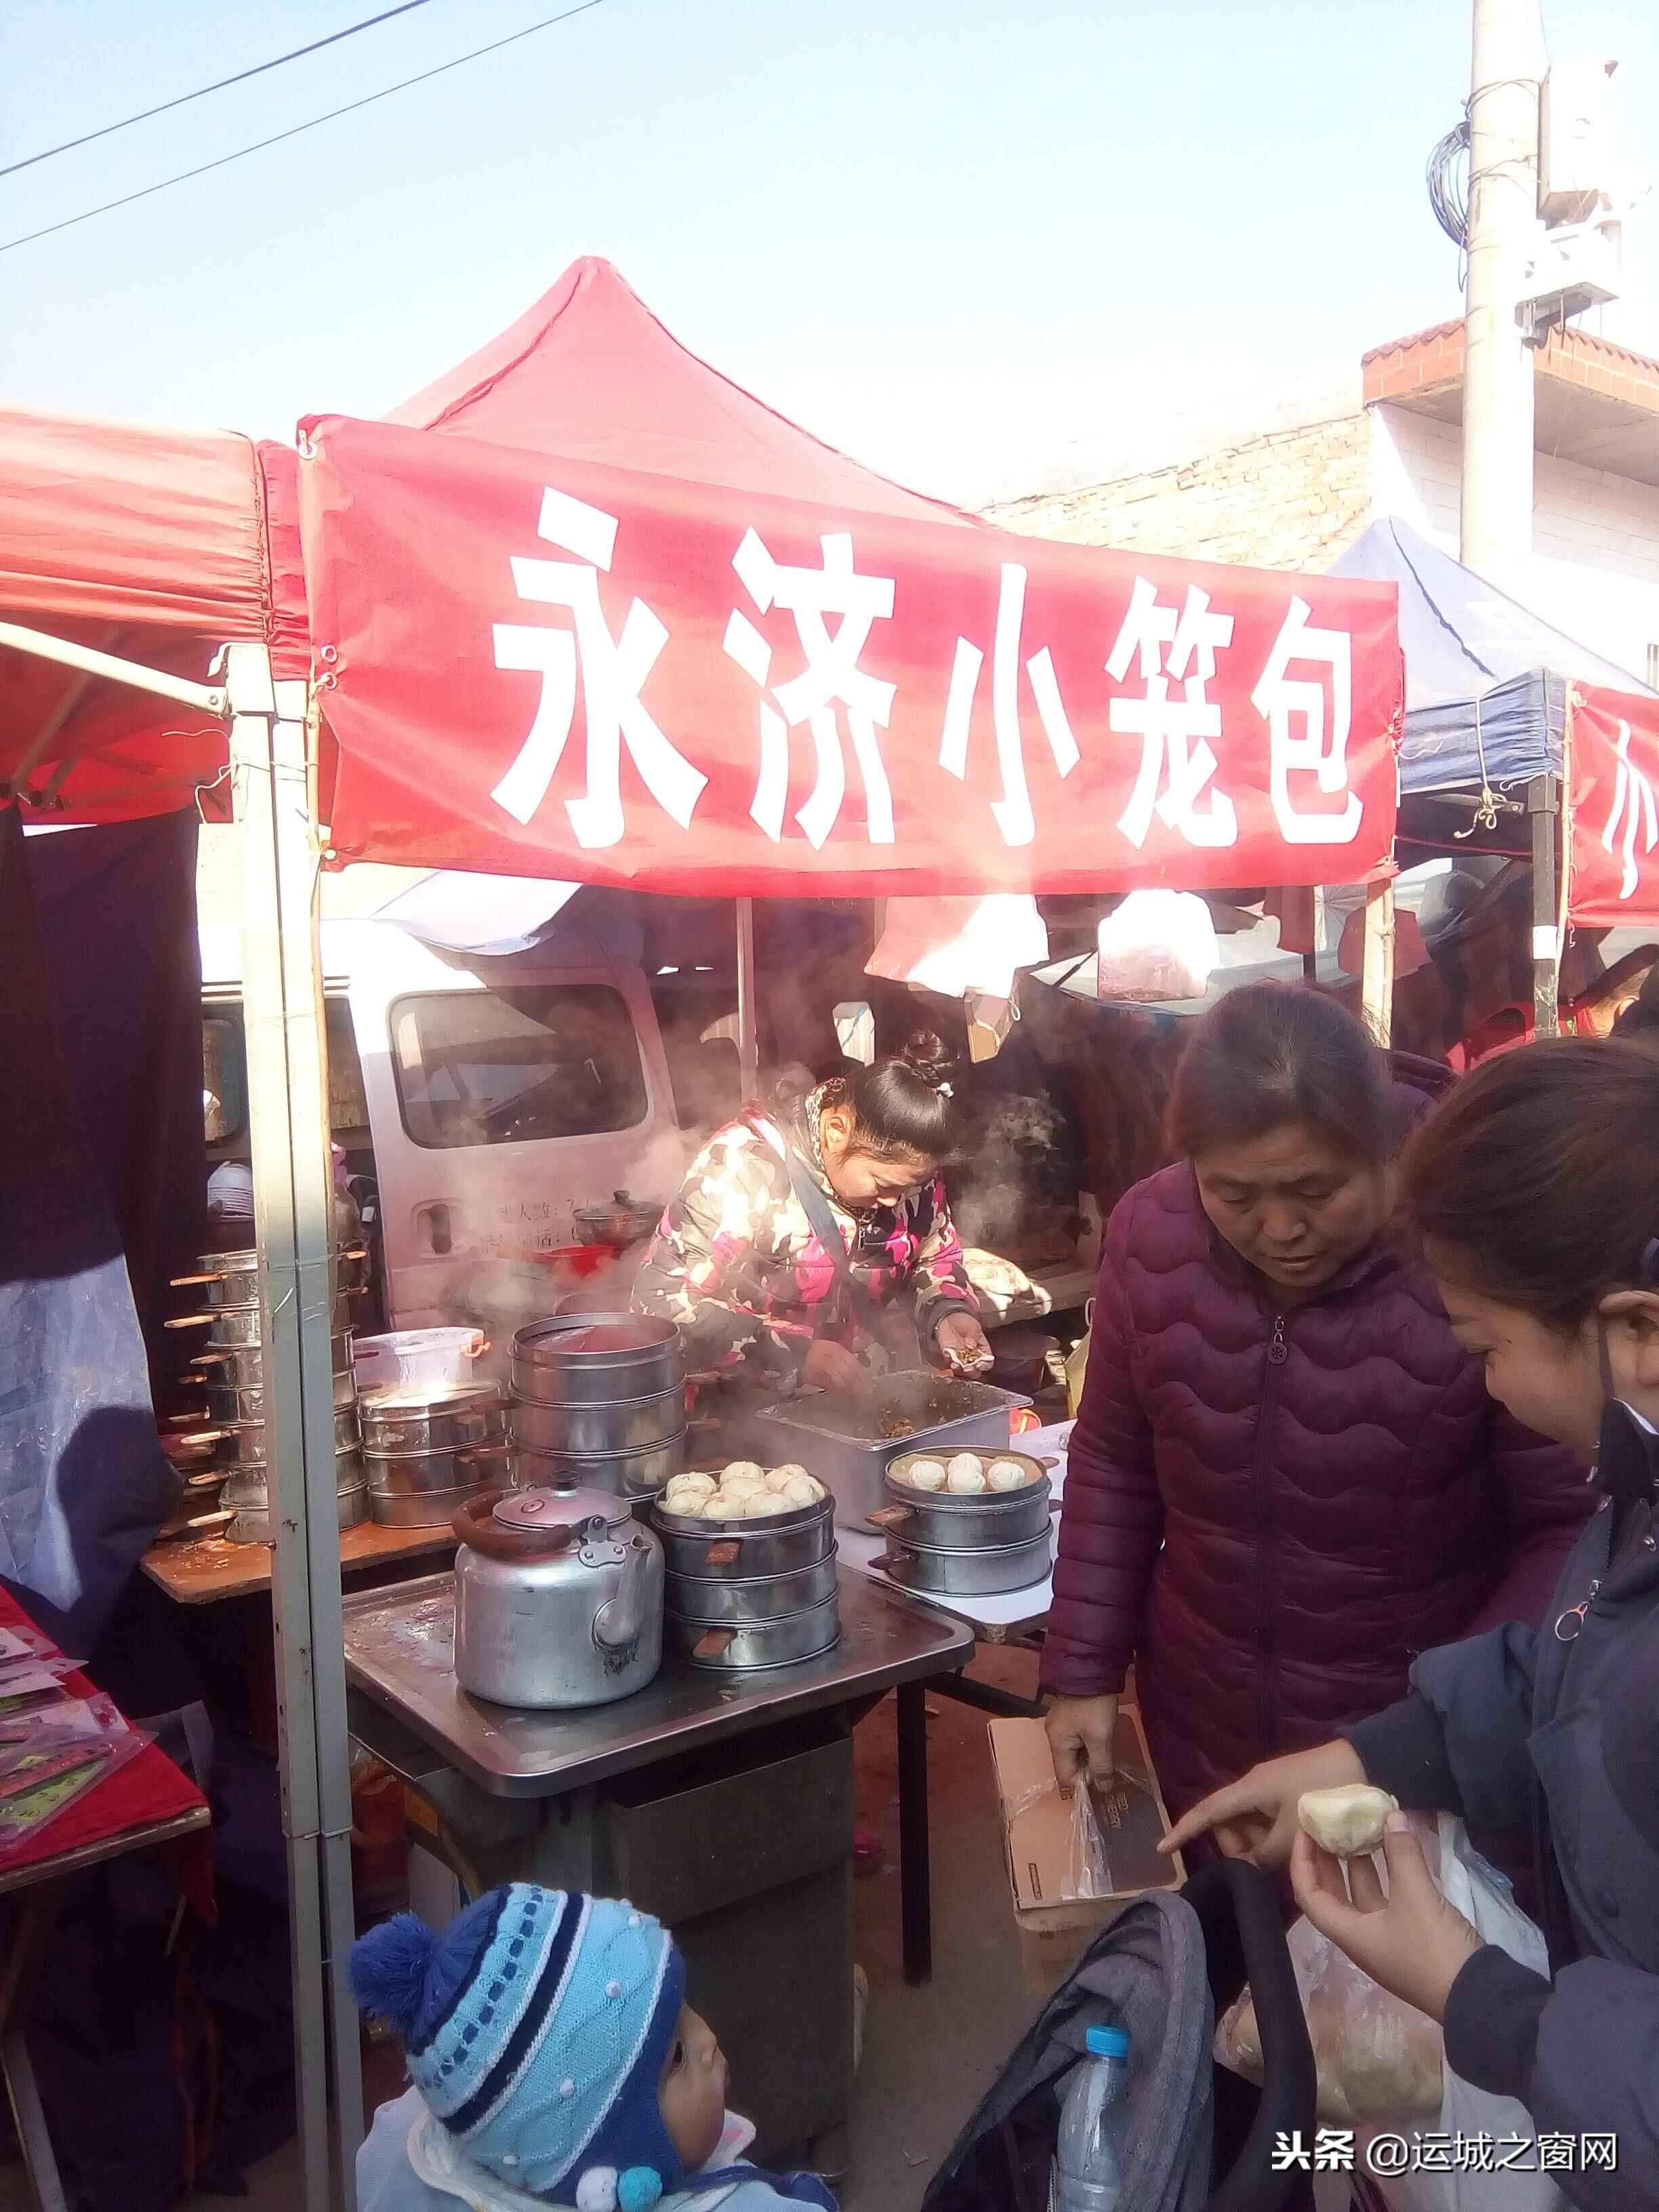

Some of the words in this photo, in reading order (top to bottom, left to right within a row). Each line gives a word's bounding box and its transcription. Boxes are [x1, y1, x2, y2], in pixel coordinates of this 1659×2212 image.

[489, 486, 1363, 851] 永济小笼包
